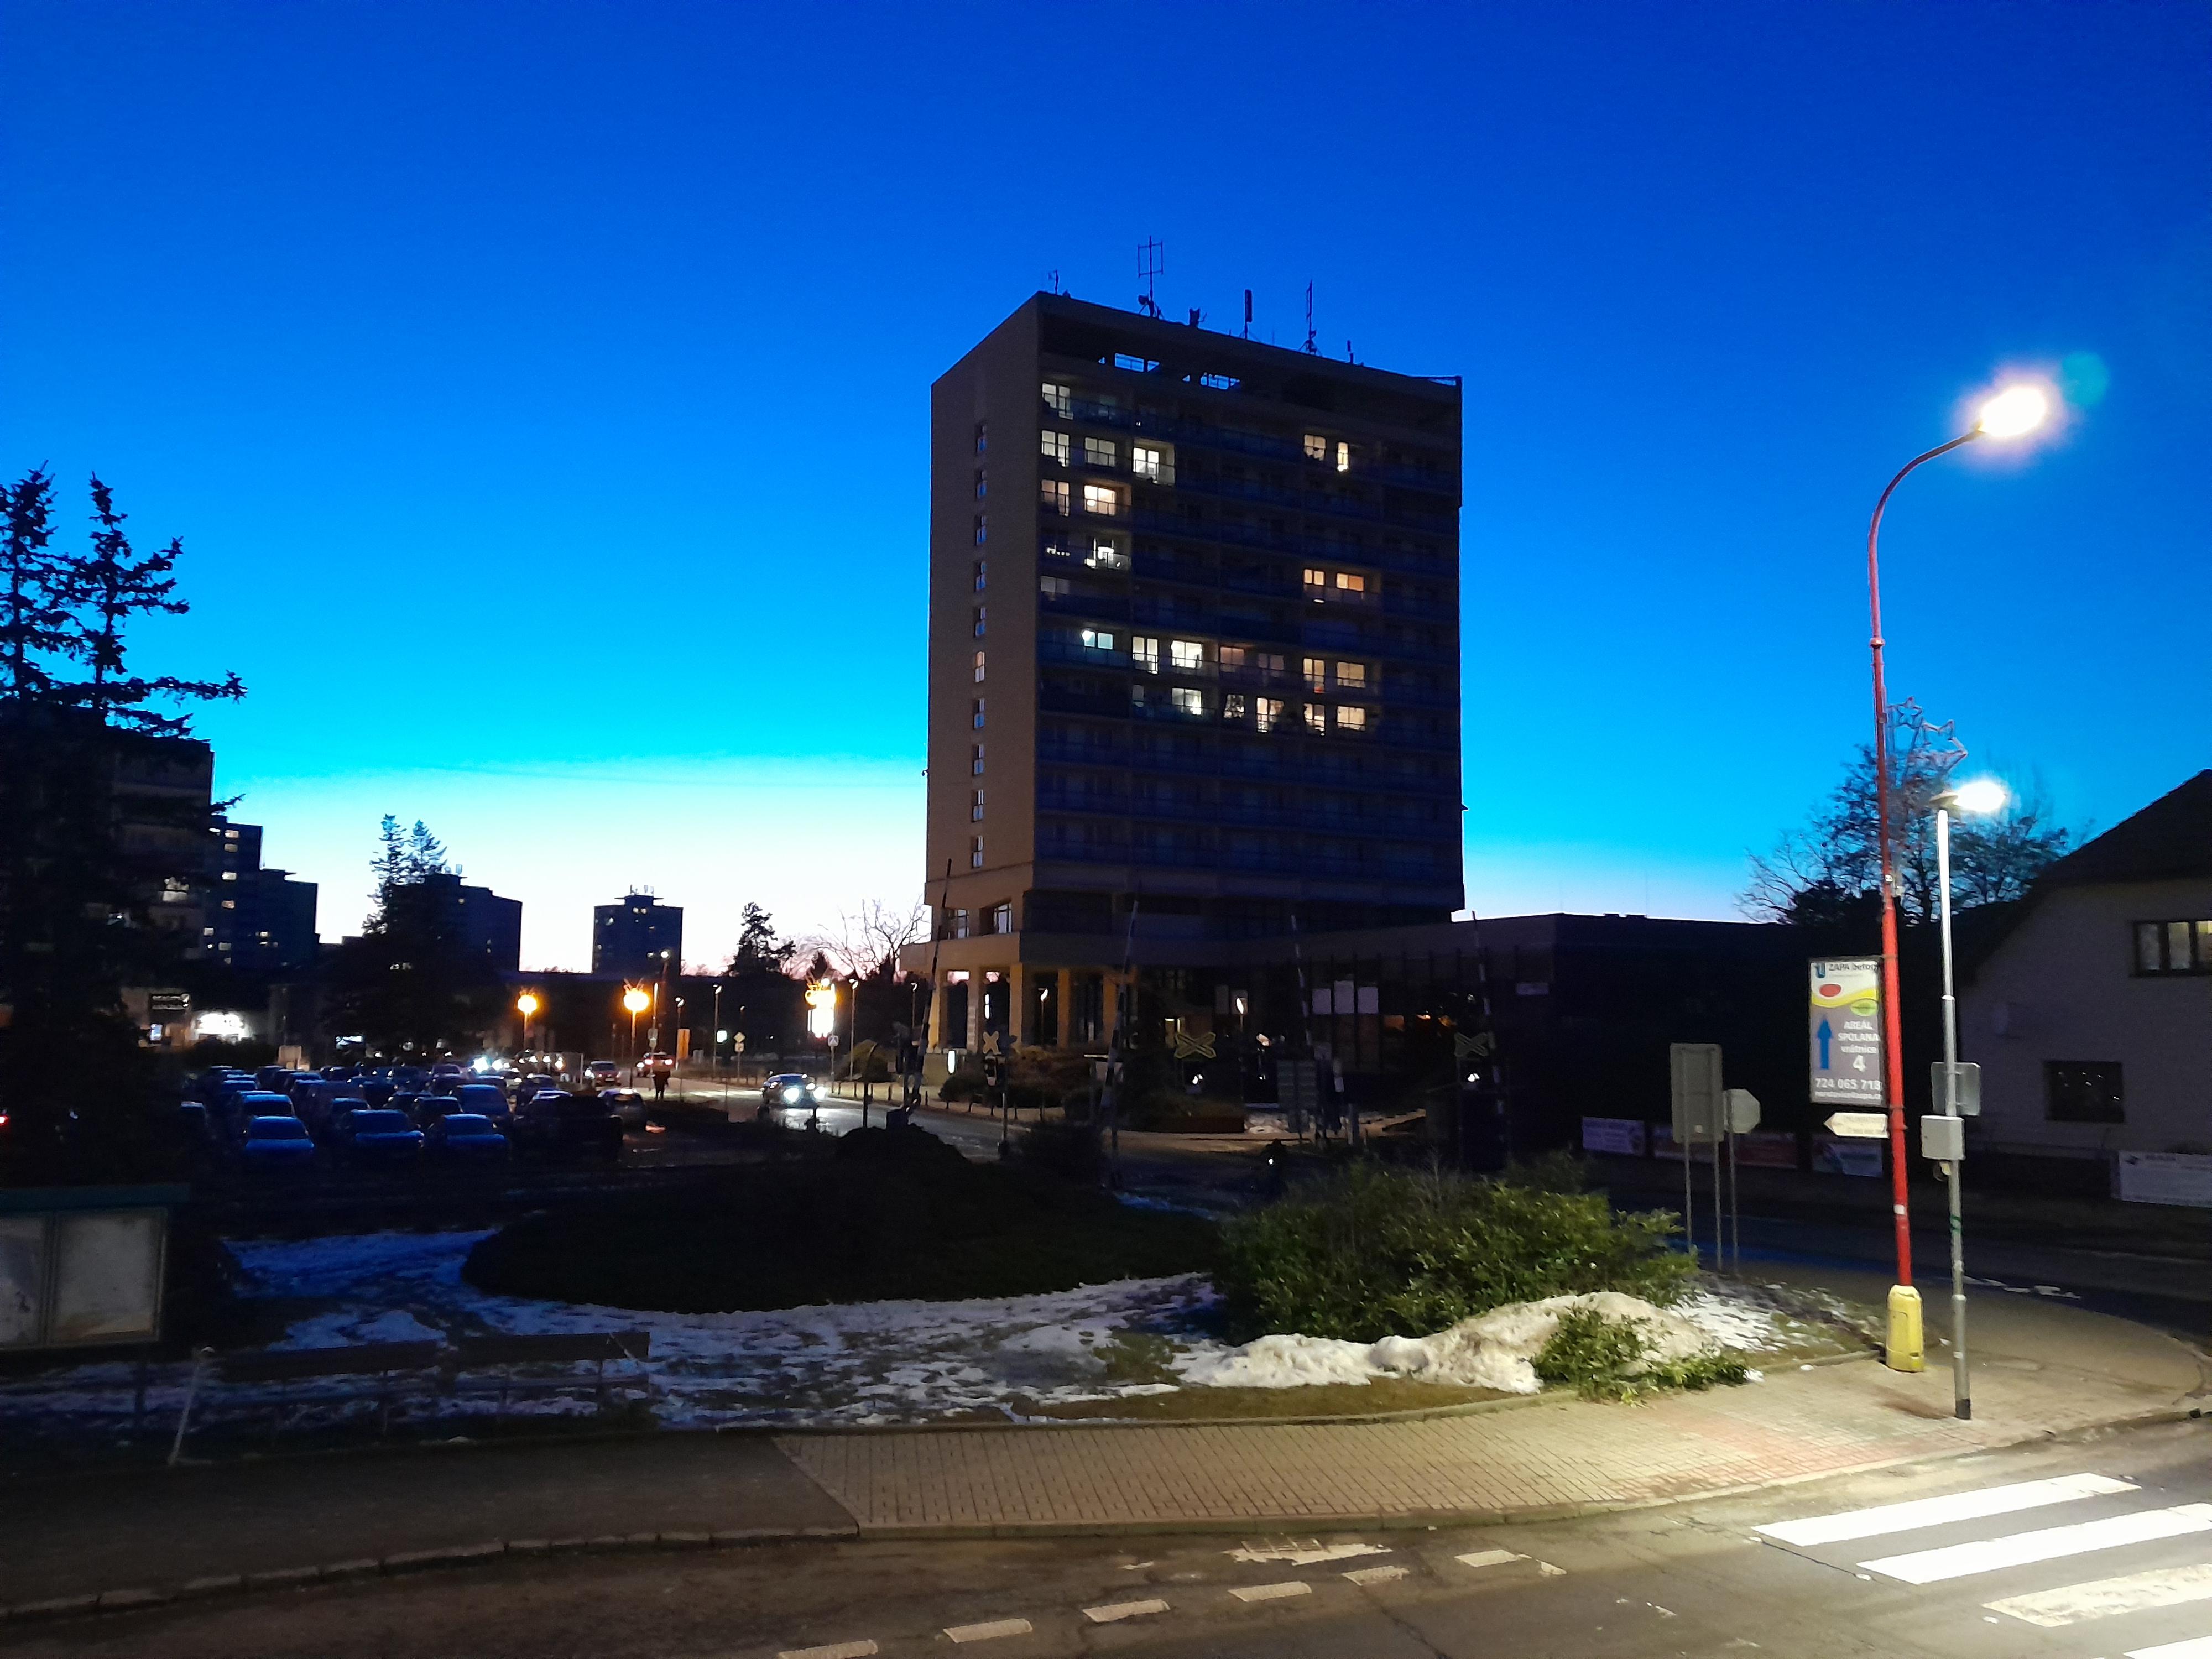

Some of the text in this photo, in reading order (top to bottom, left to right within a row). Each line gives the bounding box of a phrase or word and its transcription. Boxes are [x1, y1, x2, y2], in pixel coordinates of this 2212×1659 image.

[1838, 1032, 1880, 1042] SPOLANA
[1853, 1055, 1866, 1072] 4
[1815, 1078, 1835, 1088] 724
[1837, 1078, 1857, 1089] 065
